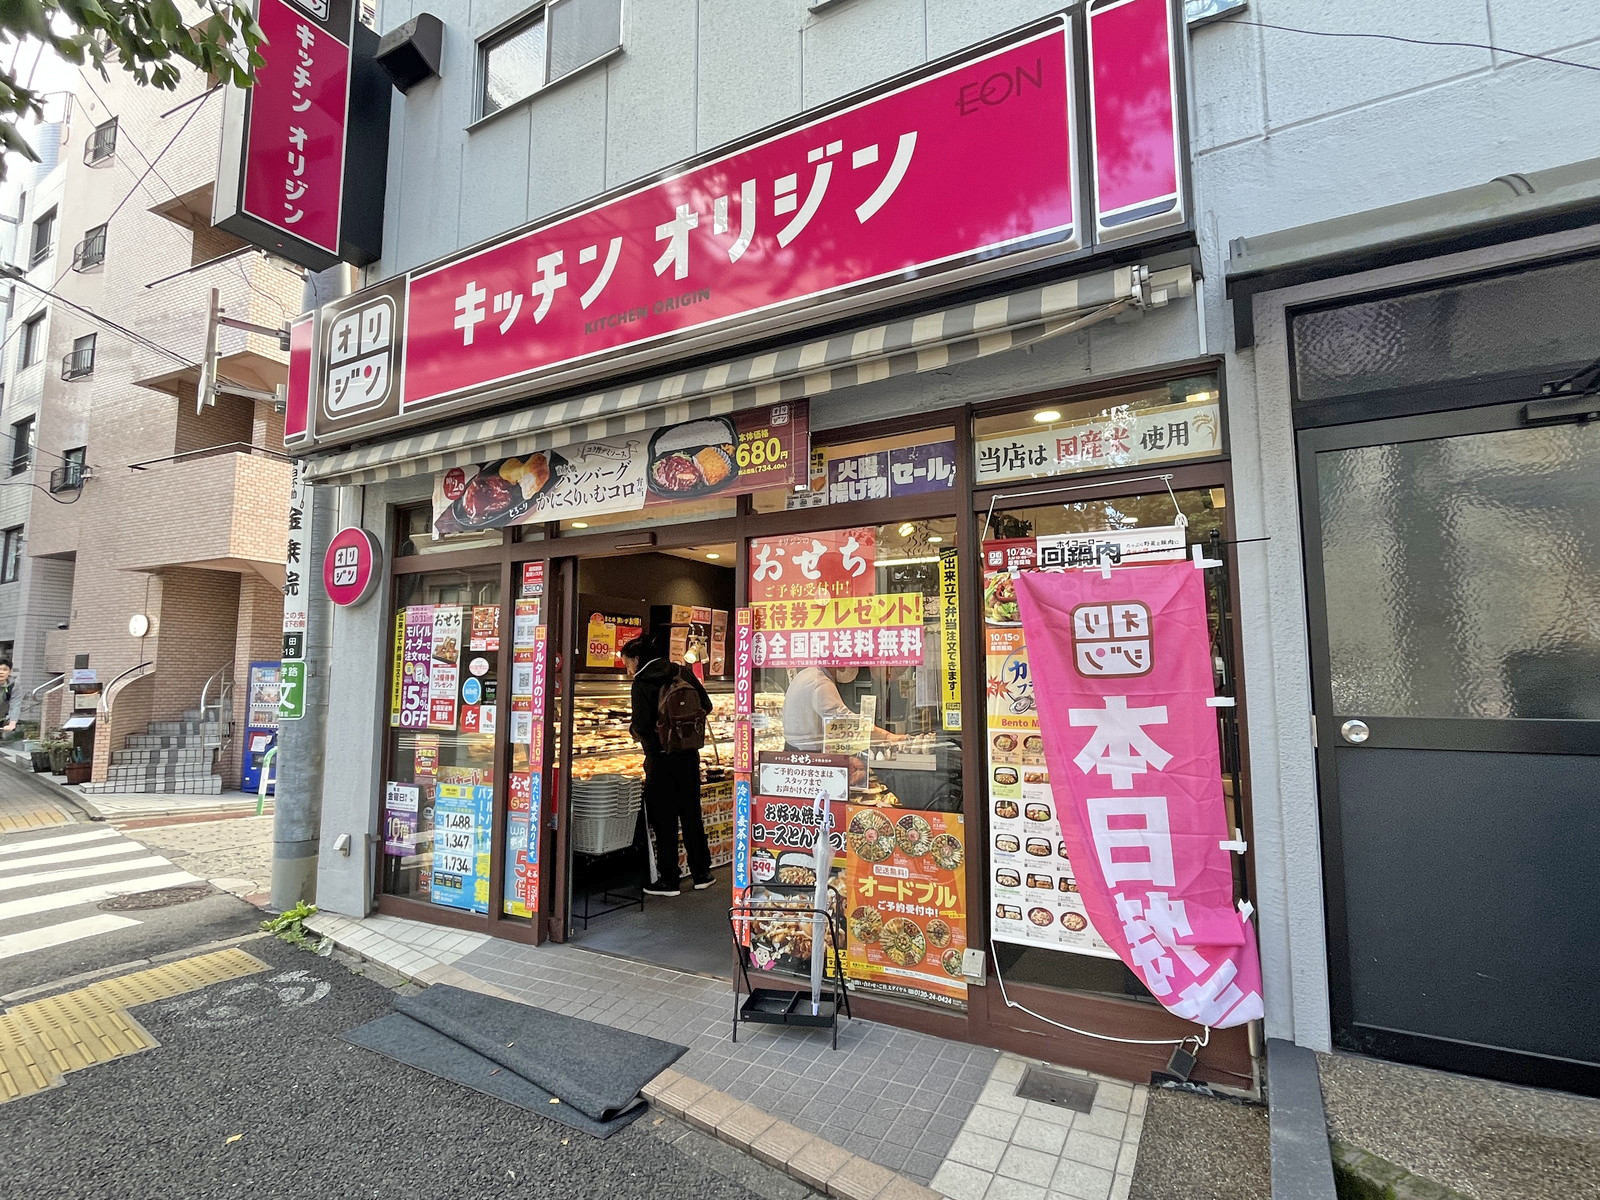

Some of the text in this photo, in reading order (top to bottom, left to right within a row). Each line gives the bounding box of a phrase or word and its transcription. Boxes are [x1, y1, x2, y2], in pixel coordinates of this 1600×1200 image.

[284, 24, 315, 224] キッチン オリジン
[454, 131, 918, 346] キッチン オリジン
[584, 288, 711, 335] KITCHEN ORIGIN
[738, 429, 769, 442] 本体価格
[979, 420, 1189, 474] 当店は 国産米 使用
[555, 460, 632, 488] ハンバーグ
[829, 477, 887, 504] 揚げ物
[752, 535, 867, 582] おせち
[765, 580, 850, 598] ご予約受付中!
[434, 612, 461, 627] おせち
[406, 625, 431, 637] モバイル
[405, 637, 431, 651] オーダーで
[589, 642, 609, 655] 999
[754, 633, 764, 663] または
[768, 627, 922, 660] 全国配送料無料
[404, 651, 431, 662] 注文すると
[401, 709, 428, 727] OFF
[1002, 718, 1028, 727] Bento
[773, 767, 834, 778] ご予約のお客さまは
[784, 777, 822, 787] スタッフまで
[858, 875, 957, 909] オードブル
[878, 900, 939, 918] ご予約受付中!
